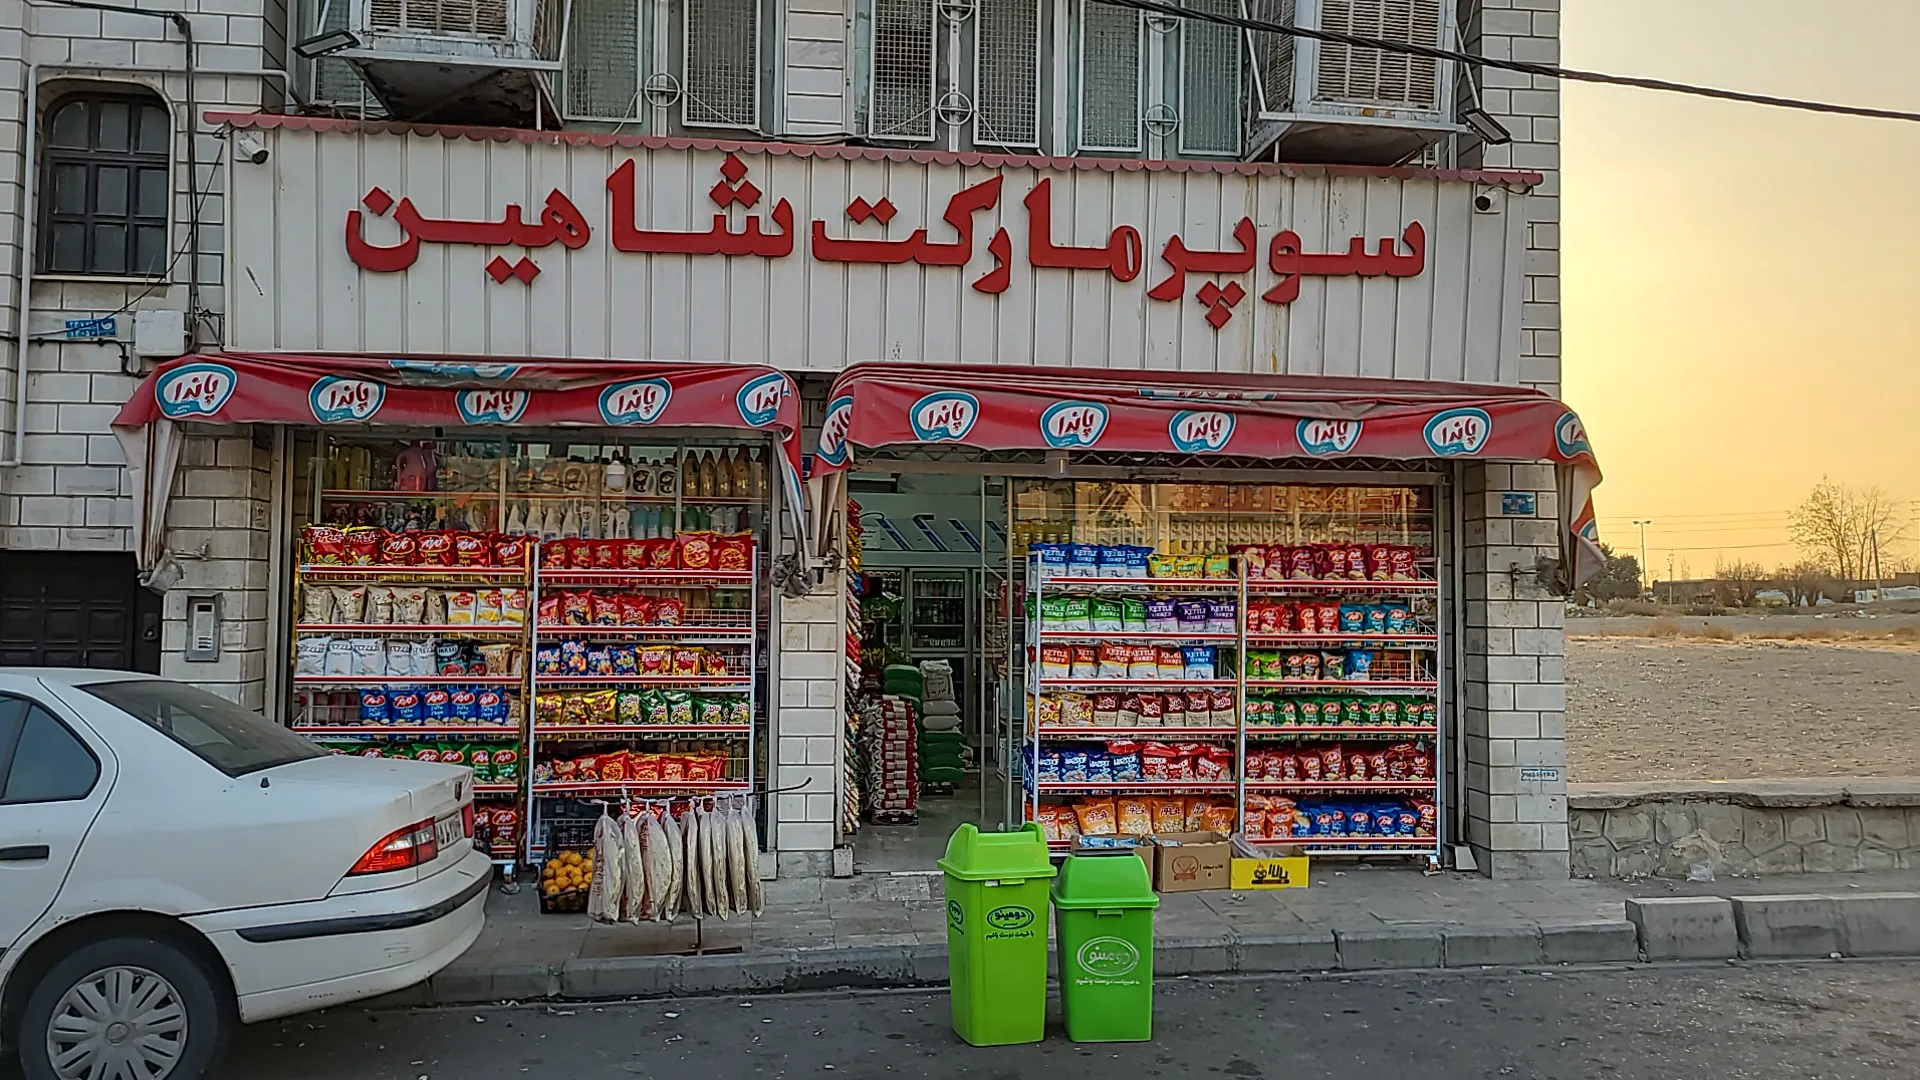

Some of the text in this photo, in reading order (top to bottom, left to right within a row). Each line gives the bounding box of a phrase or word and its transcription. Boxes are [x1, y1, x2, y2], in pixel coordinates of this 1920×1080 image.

[345, 154, 795, 286] شاهین
[174, 373, 219, 405] پاندا
[328, 382, 370, 412] پاندا
[617, 384, 656, 415] پاندا
[927, 402, 964, 432] پاندا
[1057, 409, 1094, 435] پاندا
[1186, 413, 1222, 442] پاندا
[1441, 418, 1477, 447] پاندا
[994, 909, 1026, 920] دومینو
